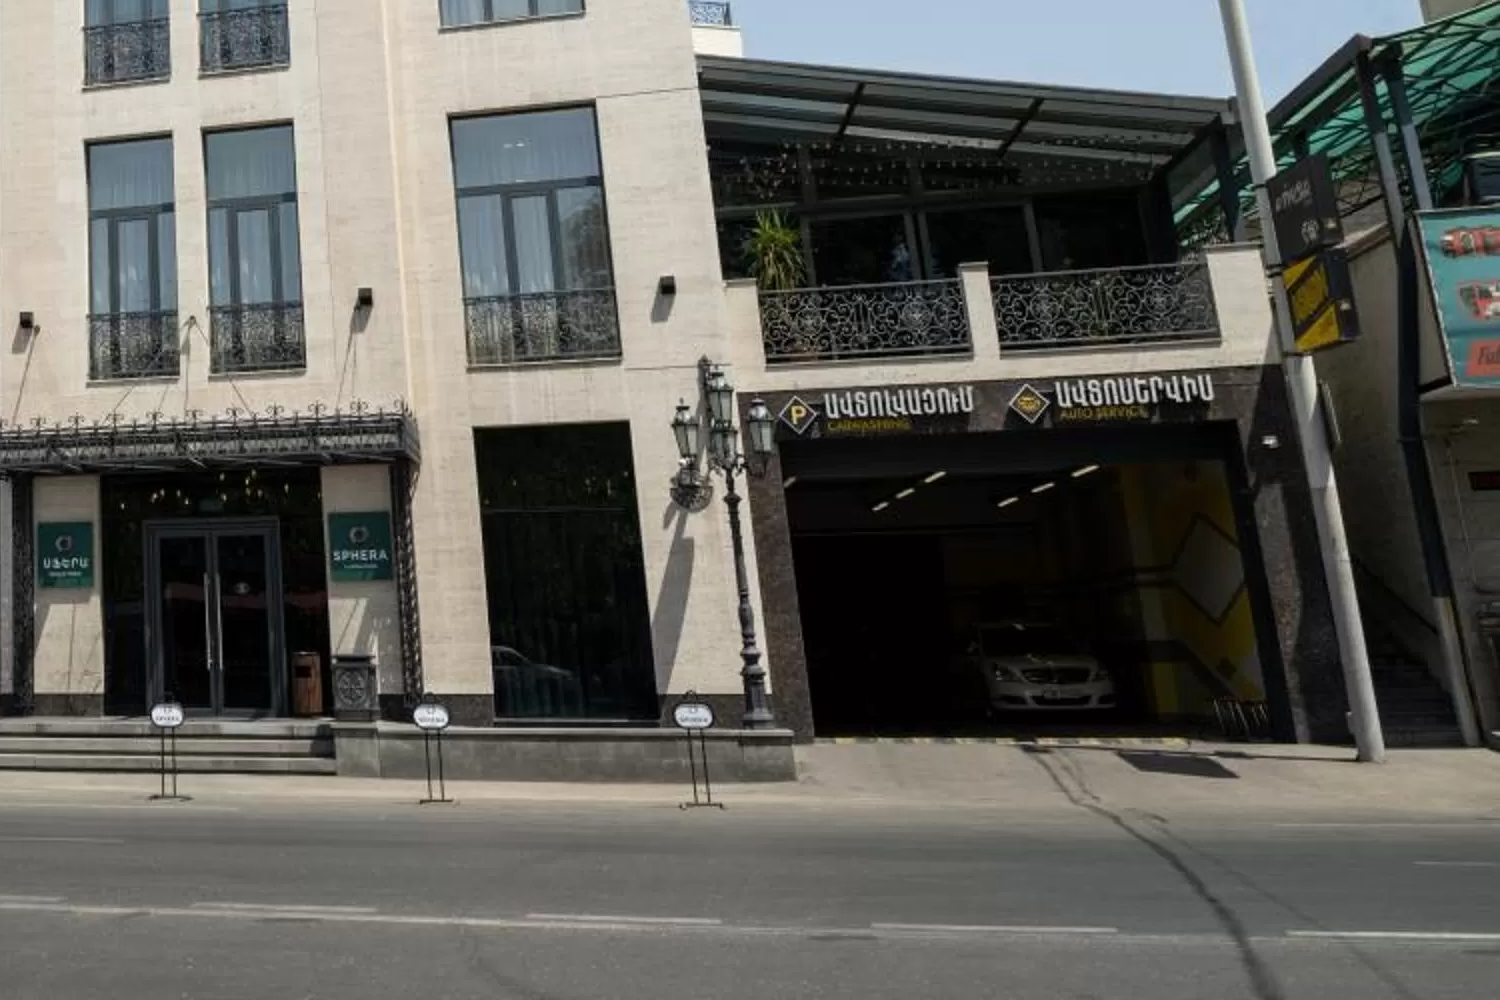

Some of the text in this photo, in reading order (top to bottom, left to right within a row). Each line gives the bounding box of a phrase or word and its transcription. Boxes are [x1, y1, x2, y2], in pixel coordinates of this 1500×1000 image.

[824, 385, 974, 419] ԱՎՏՈԼՎԱՑՈՒՄ
[1054, 373, 1215, 408] ԱՎՏՈՍԵՐՎԻՍ
[790, 405, 807, 425] P
[333, 549, 389, 561] SPHERA
